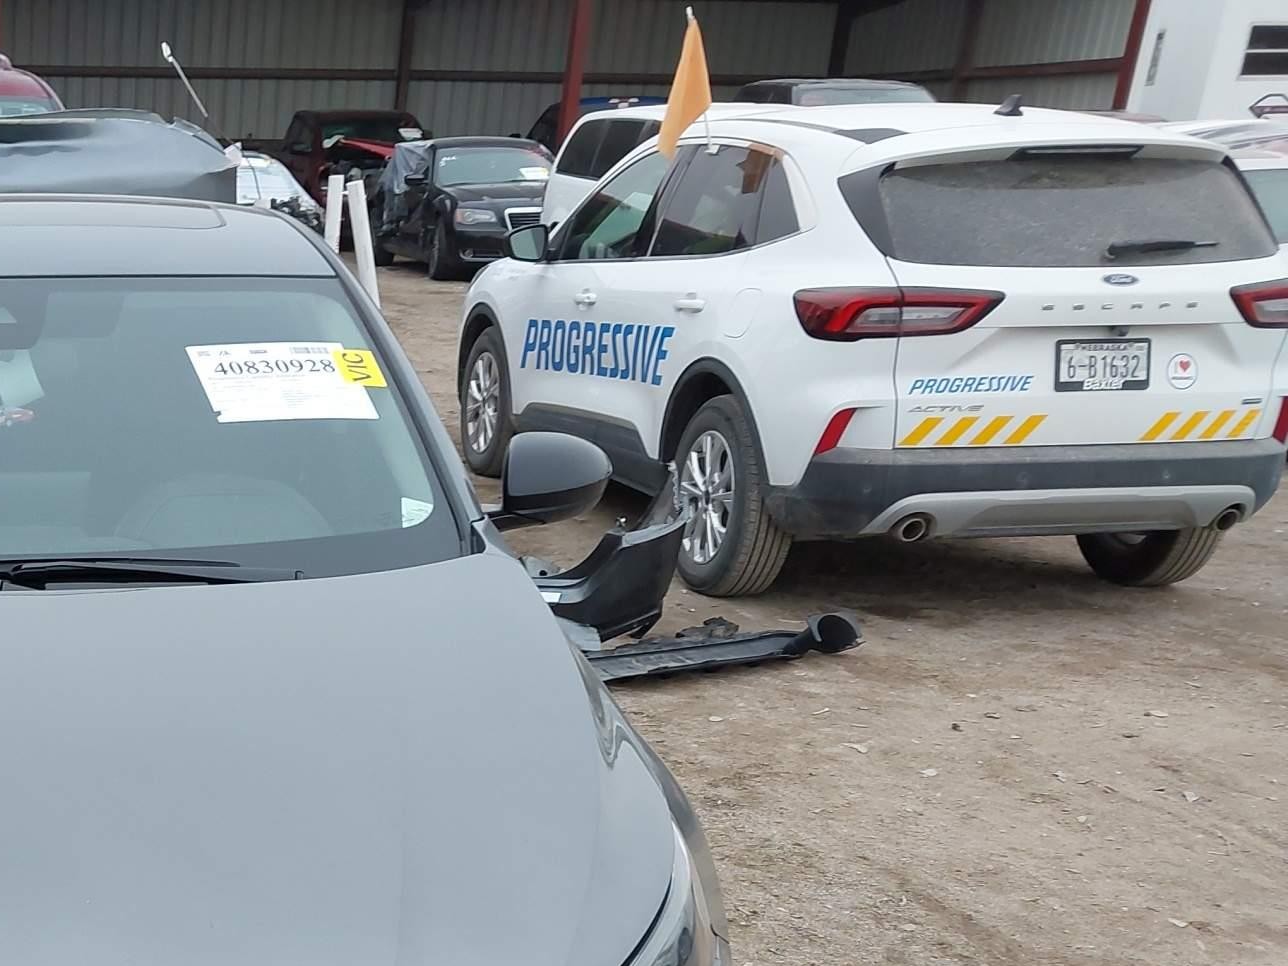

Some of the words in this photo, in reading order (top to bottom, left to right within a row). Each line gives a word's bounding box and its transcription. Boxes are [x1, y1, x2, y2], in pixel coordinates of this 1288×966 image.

[1040, 301, 1199, 311] ESCAPE
[519, 318, 676, 386] PROGRESSIVE
[214, 358, 336, 376] 40830928
[341, 352, 373, 382] VIC
[1067, 354, 1141, 379] 6-B1632
[908, 375, 1035, 396] PROGRESSIVE
[907, 403, 986, 413] ACTIVE
